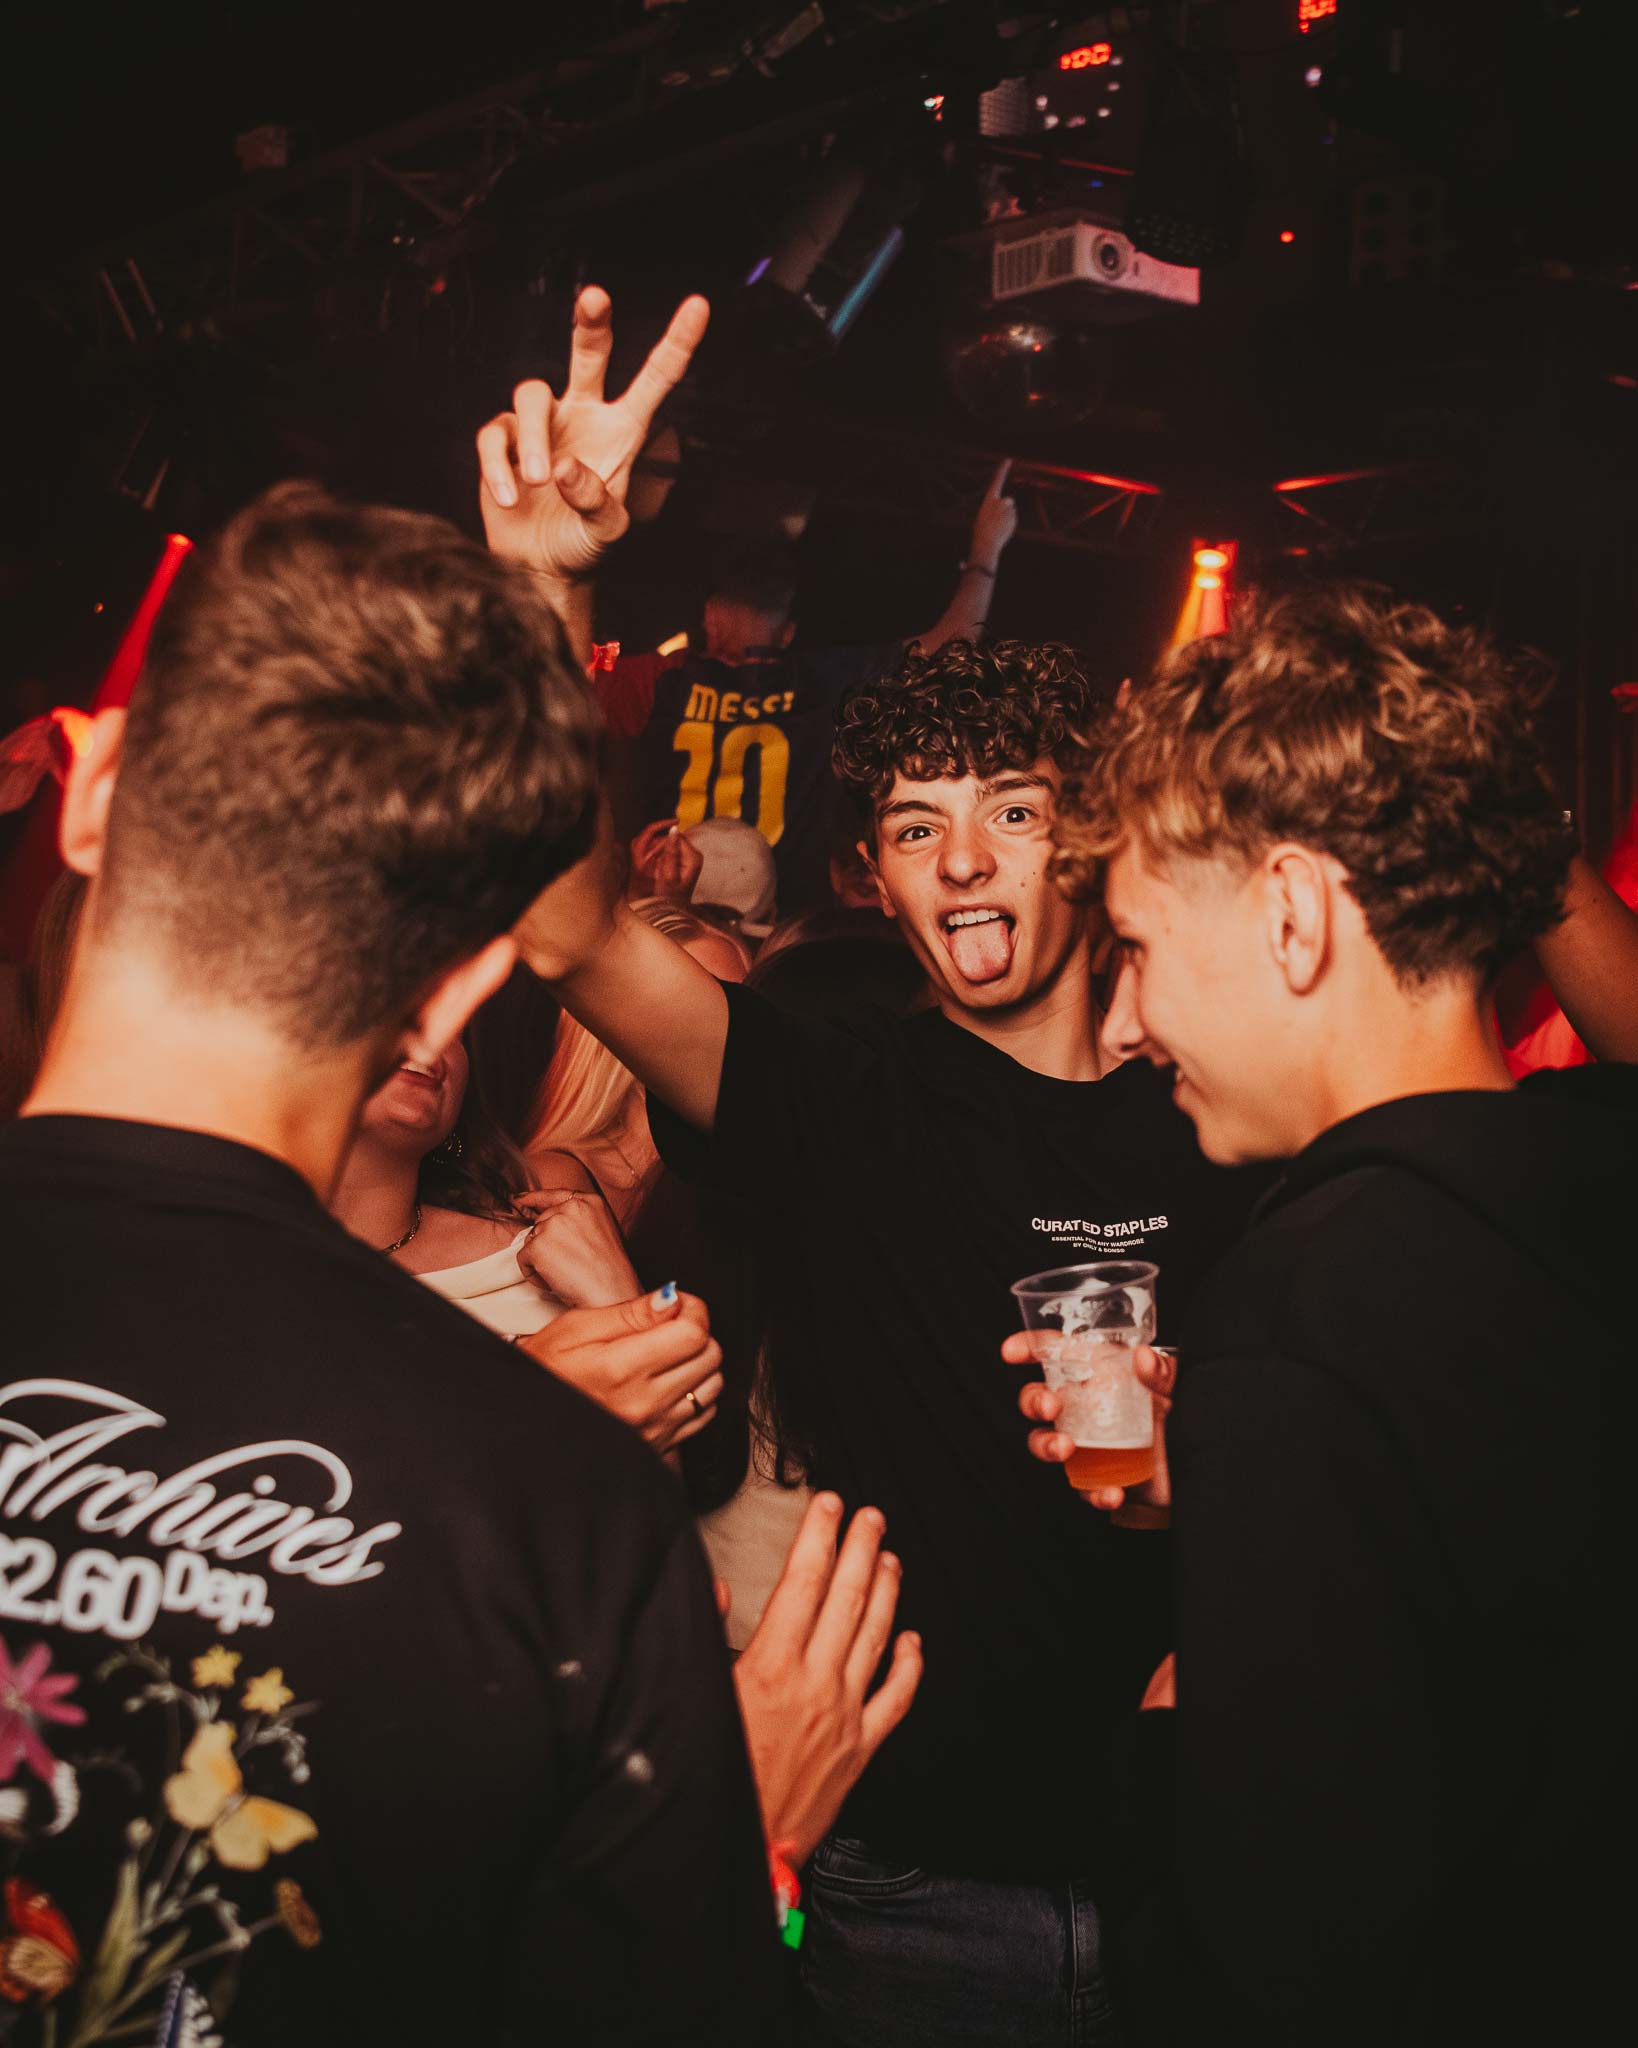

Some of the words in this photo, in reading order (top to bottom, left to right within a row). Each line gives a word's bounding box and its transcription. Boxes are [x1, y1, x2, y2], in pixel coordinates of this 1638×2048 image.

[673, 720, 789, 848] 10
[1031, 1217, 1101, 1235] CURATED
[1103, 1215, 1169, 1237] STAPLES
[1085, 1236, 1097, 1245] FOR
[1110, 1237, 1145, 1247] WARDROBE
[0, 1532, 164, 1641] 2.60
[162, 1549, 275, 1635] Dep.
